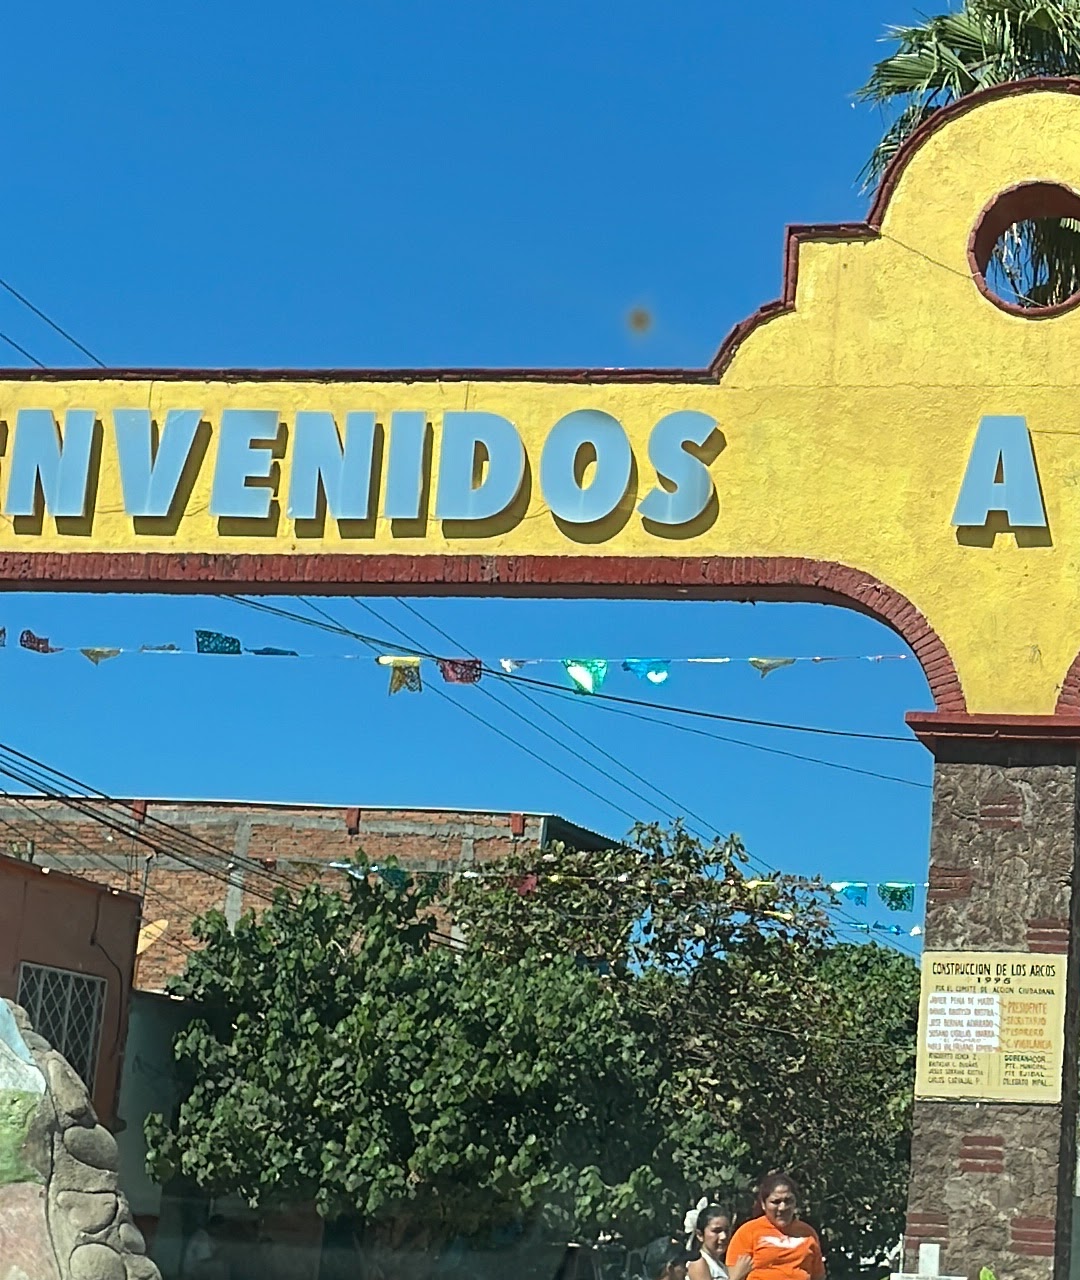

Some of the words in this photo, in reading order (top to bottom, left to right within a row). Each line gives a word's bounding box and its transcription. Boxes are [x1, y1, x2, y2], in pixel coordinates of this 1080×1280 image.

[0, 408, 720, 524] NVENIDOS
[951, 415, 1048, 527] A
[933, 962, 990, 975] CONSTRUCCION
[996, 964, 1006, 975] DE
[1012, 964, 1026, 976] LOS
[1030, 965, 1056, 976] ARCOS
[1008, 1001, 1047, 1015] PRESIDENTE
[1006, 1017, 1046, 1025] SECRETARIO
[1006, 1028, 1044, 1036] TESORERO
[1004, 1055, 1046, 1063] GOBERNADOR
